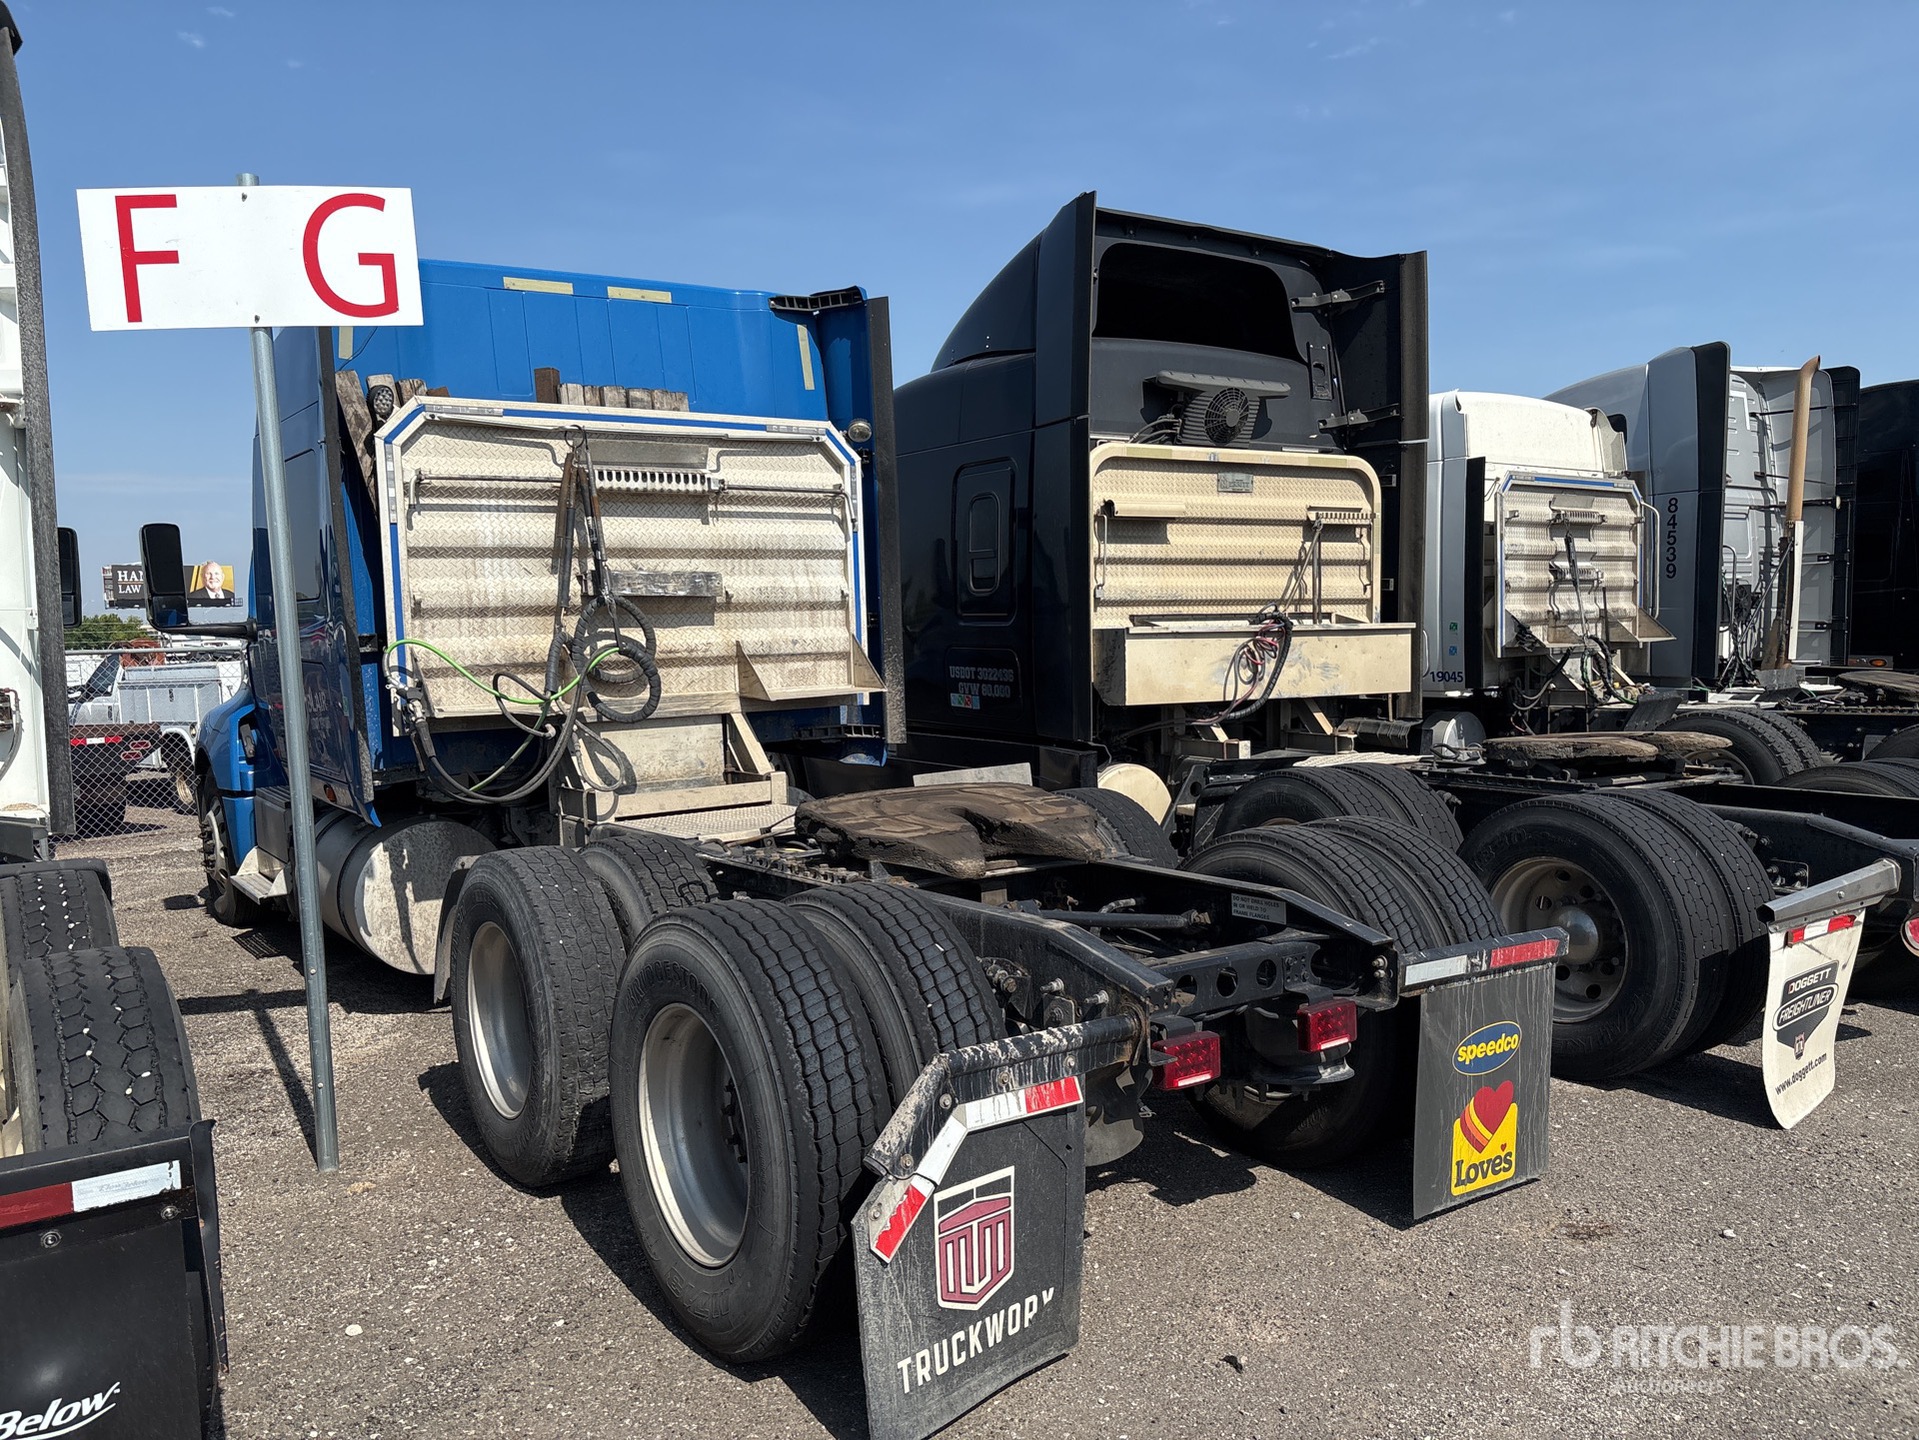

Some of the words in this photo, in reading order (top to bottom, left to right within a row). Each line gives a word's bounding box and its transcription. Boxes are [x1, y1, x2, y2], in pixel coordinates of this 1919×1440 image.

[114, 194, 180, 323] F
[302, 192, 400, 318] G
[1665, 497, 1679, 579] 84539
[118, 584, 142, 594] LAW
[949, 665, 976, 680] USDOT
[1429, 670, 1464, 683] 19045
[958, 682, 980, 695] GVW
[1788, 968, 1832, 994] DOGGETT
[1778, 989, 1832, 1024] FREIGHTLINER
[1457, 1033, 1519, 1065] speedco
[1775, 1052, 1827, 1095] www.doggett.com
